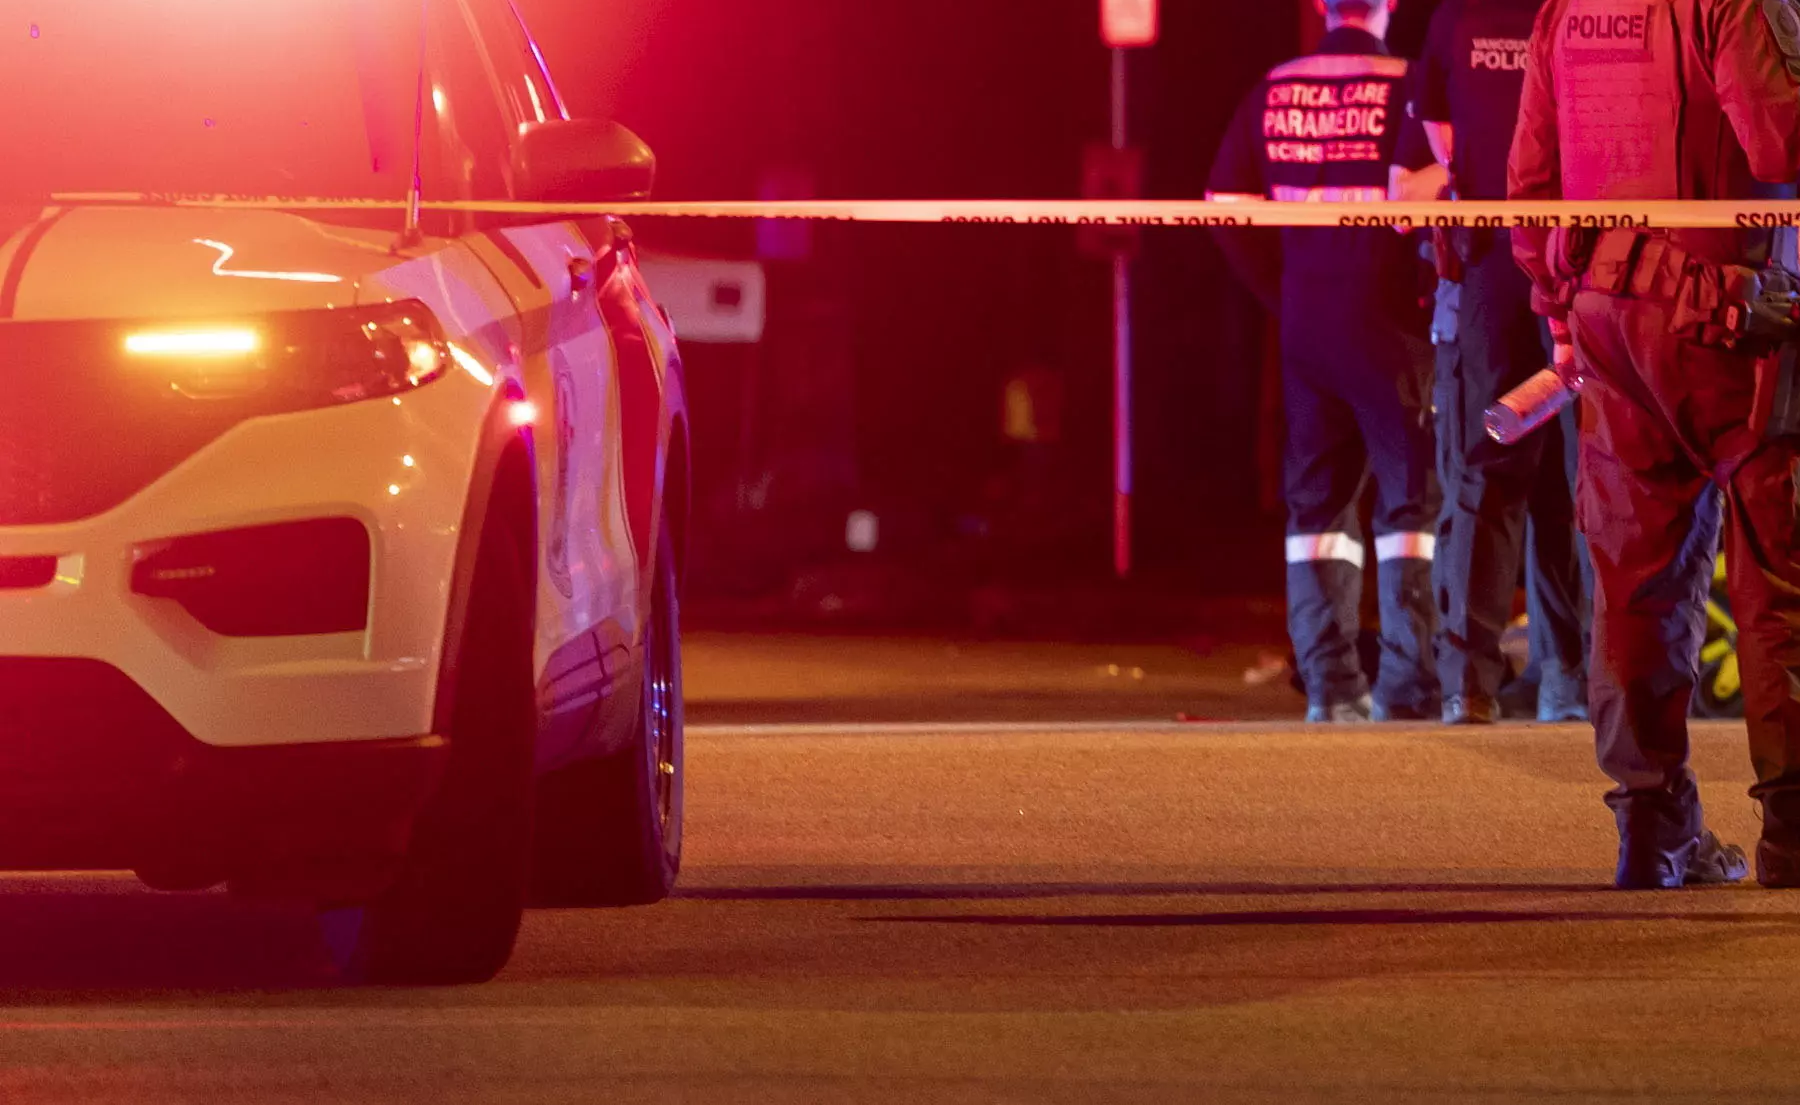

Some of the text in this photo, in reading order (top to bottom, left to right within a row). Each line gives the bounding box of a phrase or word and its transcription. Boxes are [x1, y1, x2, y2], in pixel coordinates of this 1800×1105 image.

[1567, 14, 1645, 40] POLICE
[1472, 38, 1531, 52] VANCOUV
[1470, 49, 1531, 71] POLIC
[1263, 107, 1385, 138] PARAMEDIC
